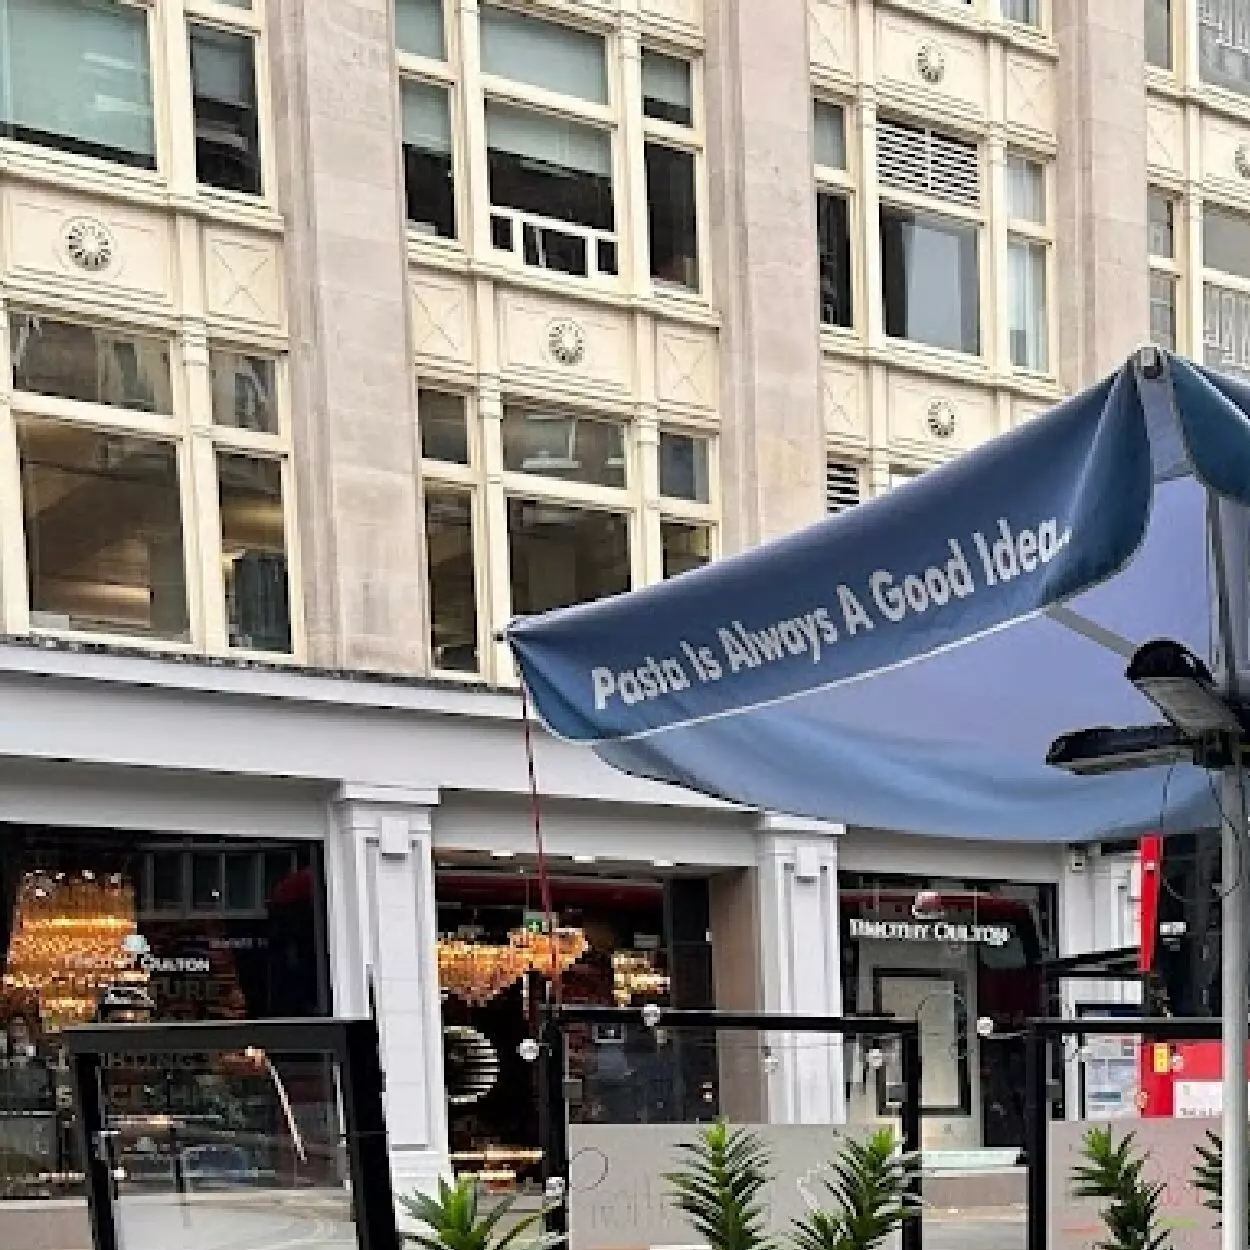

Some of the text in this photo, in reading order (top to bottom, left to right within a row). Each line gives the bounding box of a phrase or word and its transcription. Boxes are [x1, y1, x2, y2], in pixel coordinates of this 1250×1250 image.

[592, 516, 1073, 711] Pasta Is Always A Good Idea.
[850, 919, 931, 939] TIMOTHY
